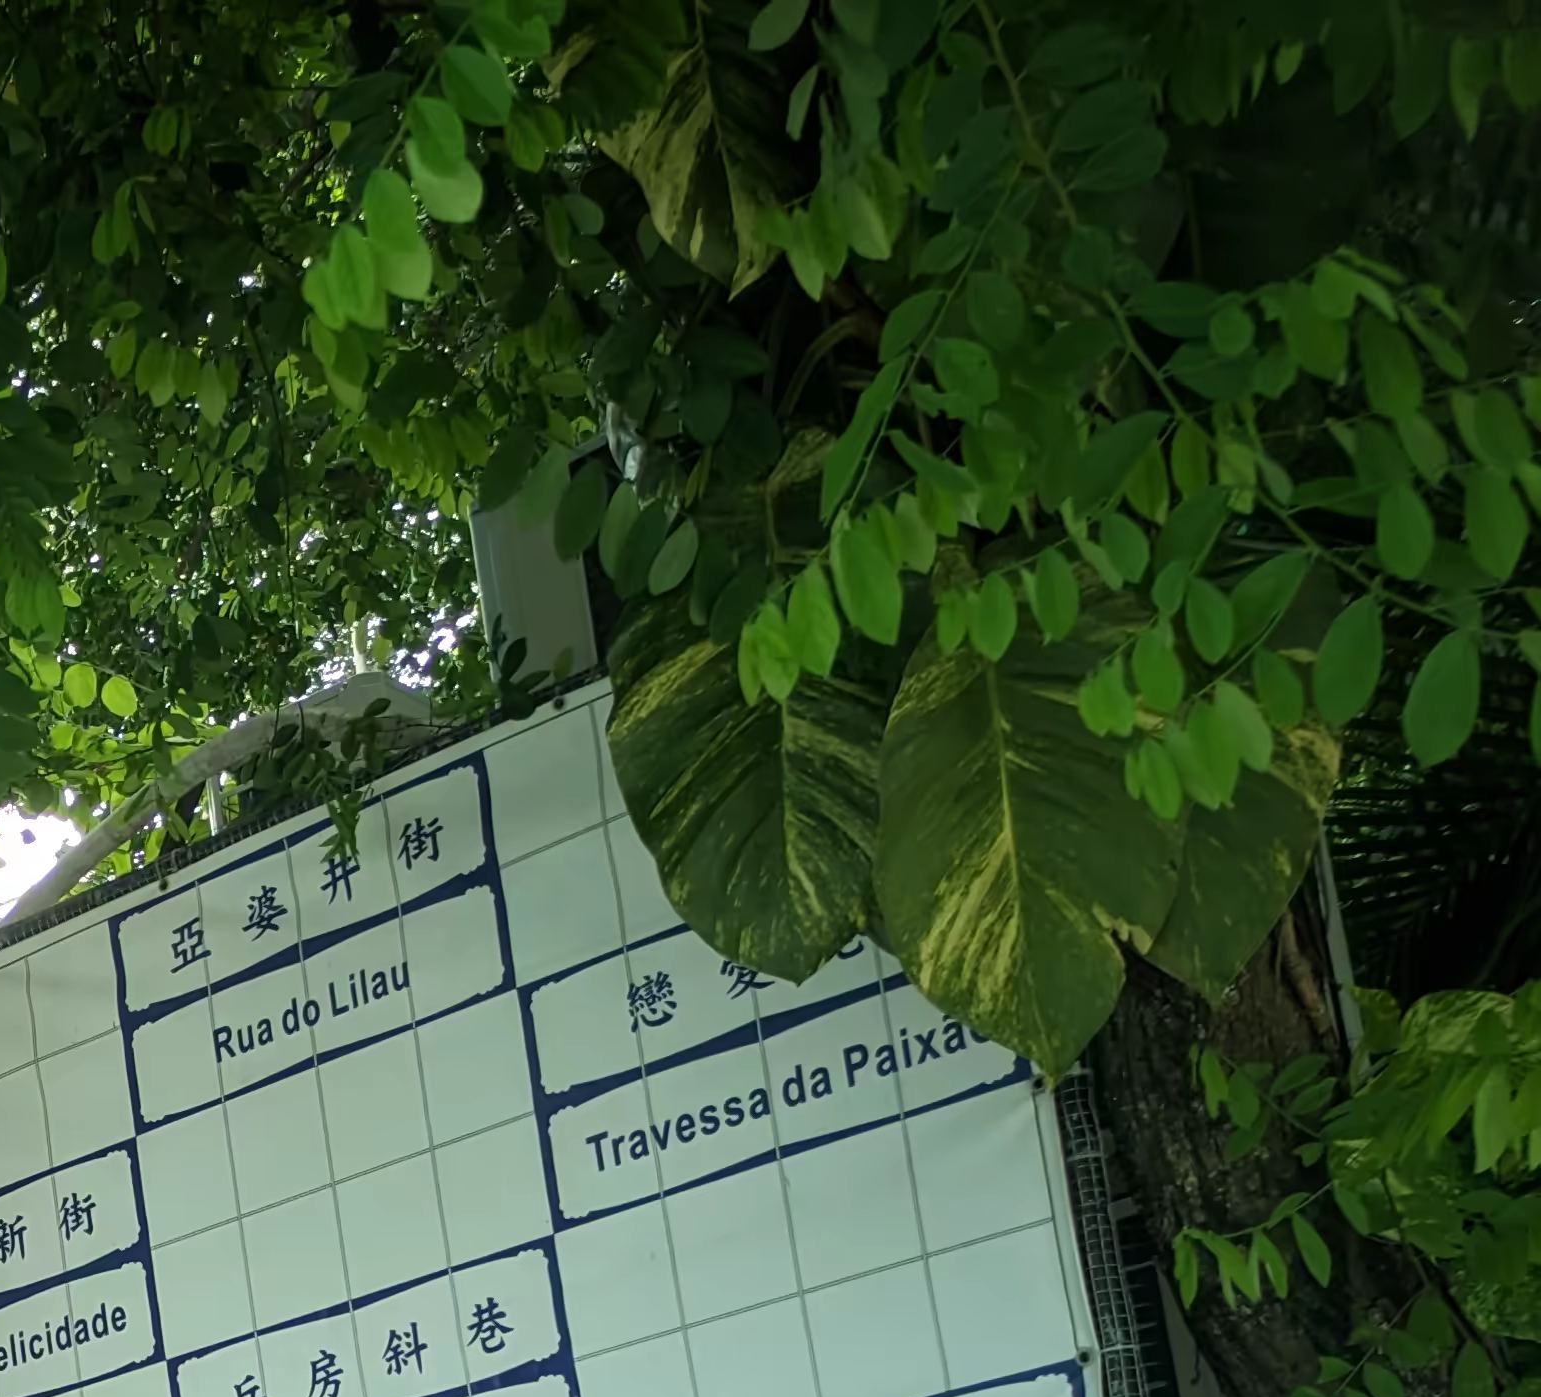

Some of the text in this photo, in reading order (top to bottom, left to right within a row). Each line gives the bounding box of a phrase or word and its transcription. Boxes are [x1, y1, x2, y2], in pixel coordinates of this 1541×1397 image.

[169, 817, 444, 974] 亞婆井街
[213, 962, 411, 1063] Rua do Lilau
[586, 1086, 772, 1172] Travessa
[781, 1064, 833, 1107] da
